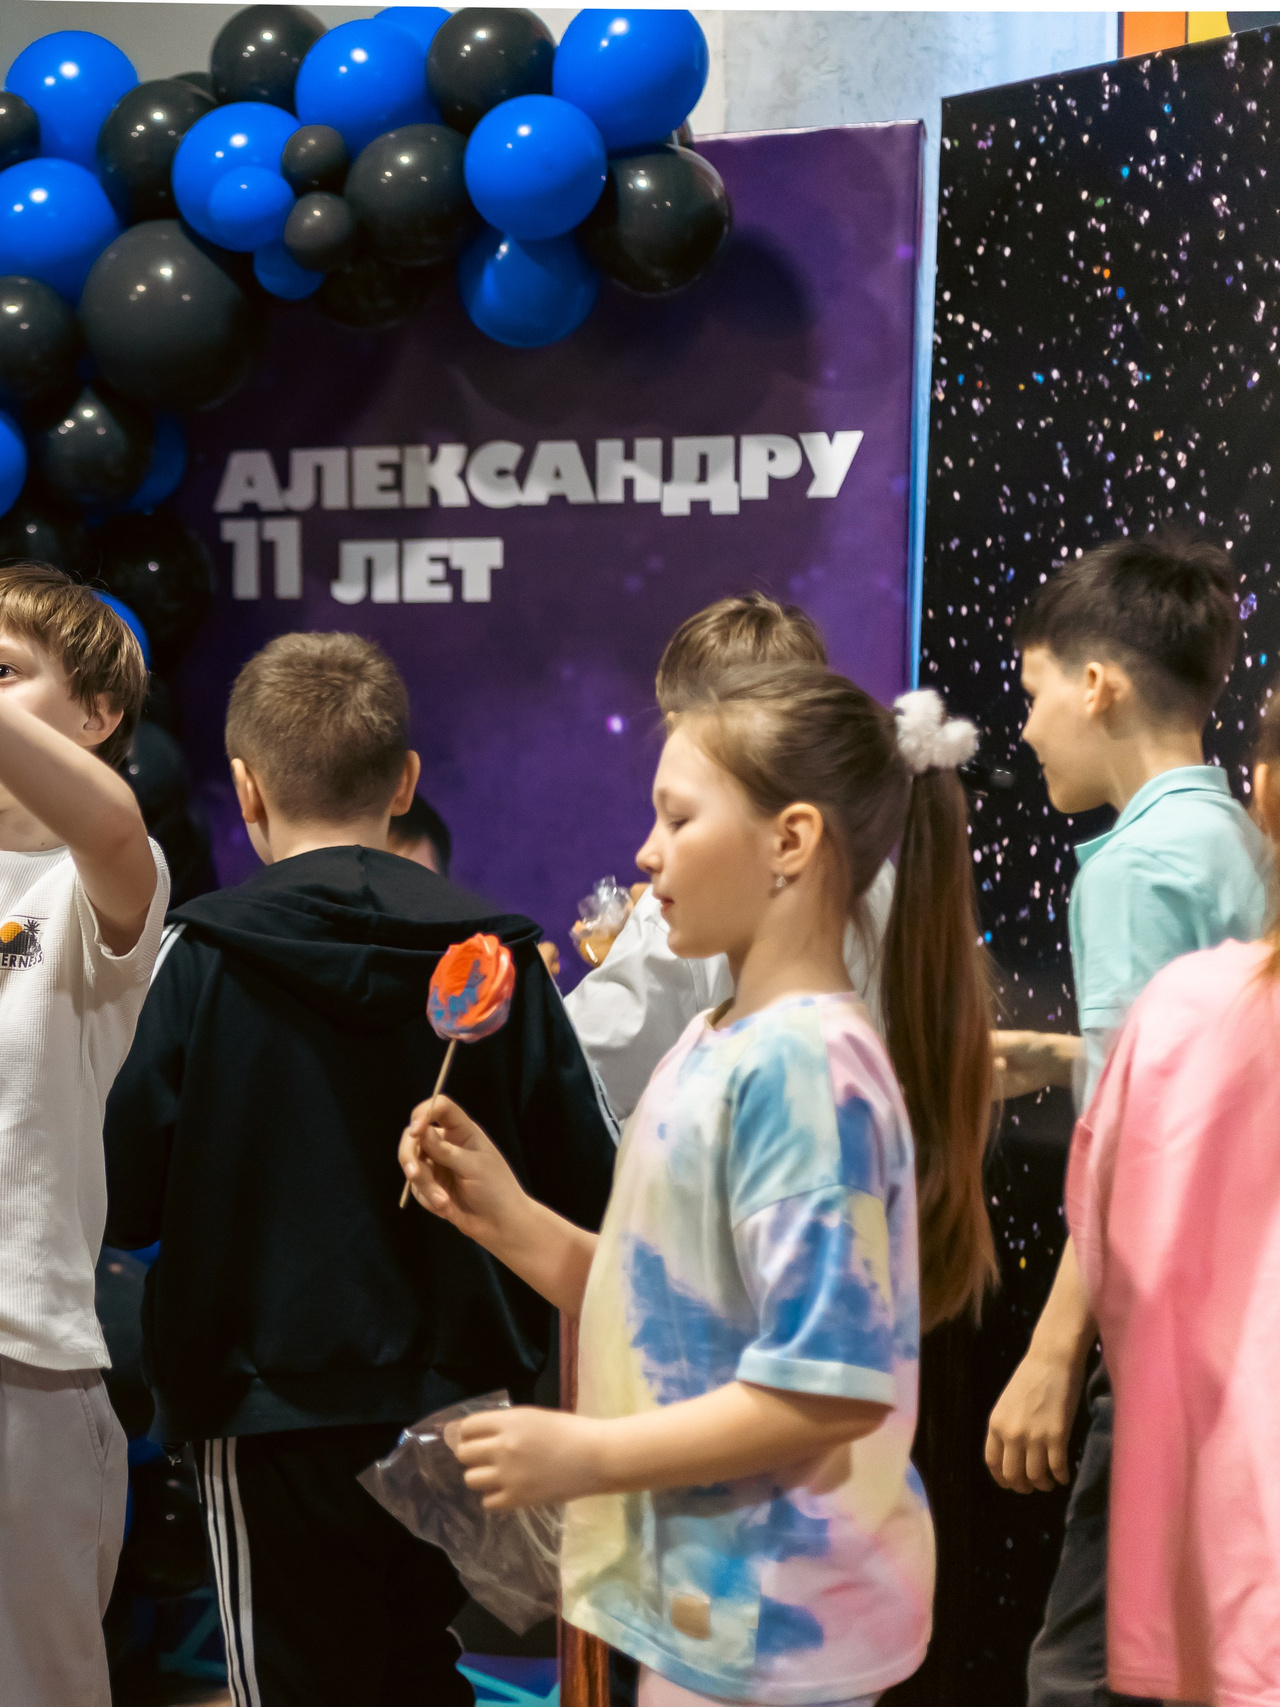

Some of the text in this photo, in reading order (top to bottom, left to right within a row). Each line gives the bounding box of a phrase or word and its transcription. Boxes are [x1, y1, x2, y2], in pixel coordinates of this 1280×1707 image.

[214, 430, 864, 516] АЛЕКСАНДРУ
[222, 517, 504, 605] 11 ЛЕТ
